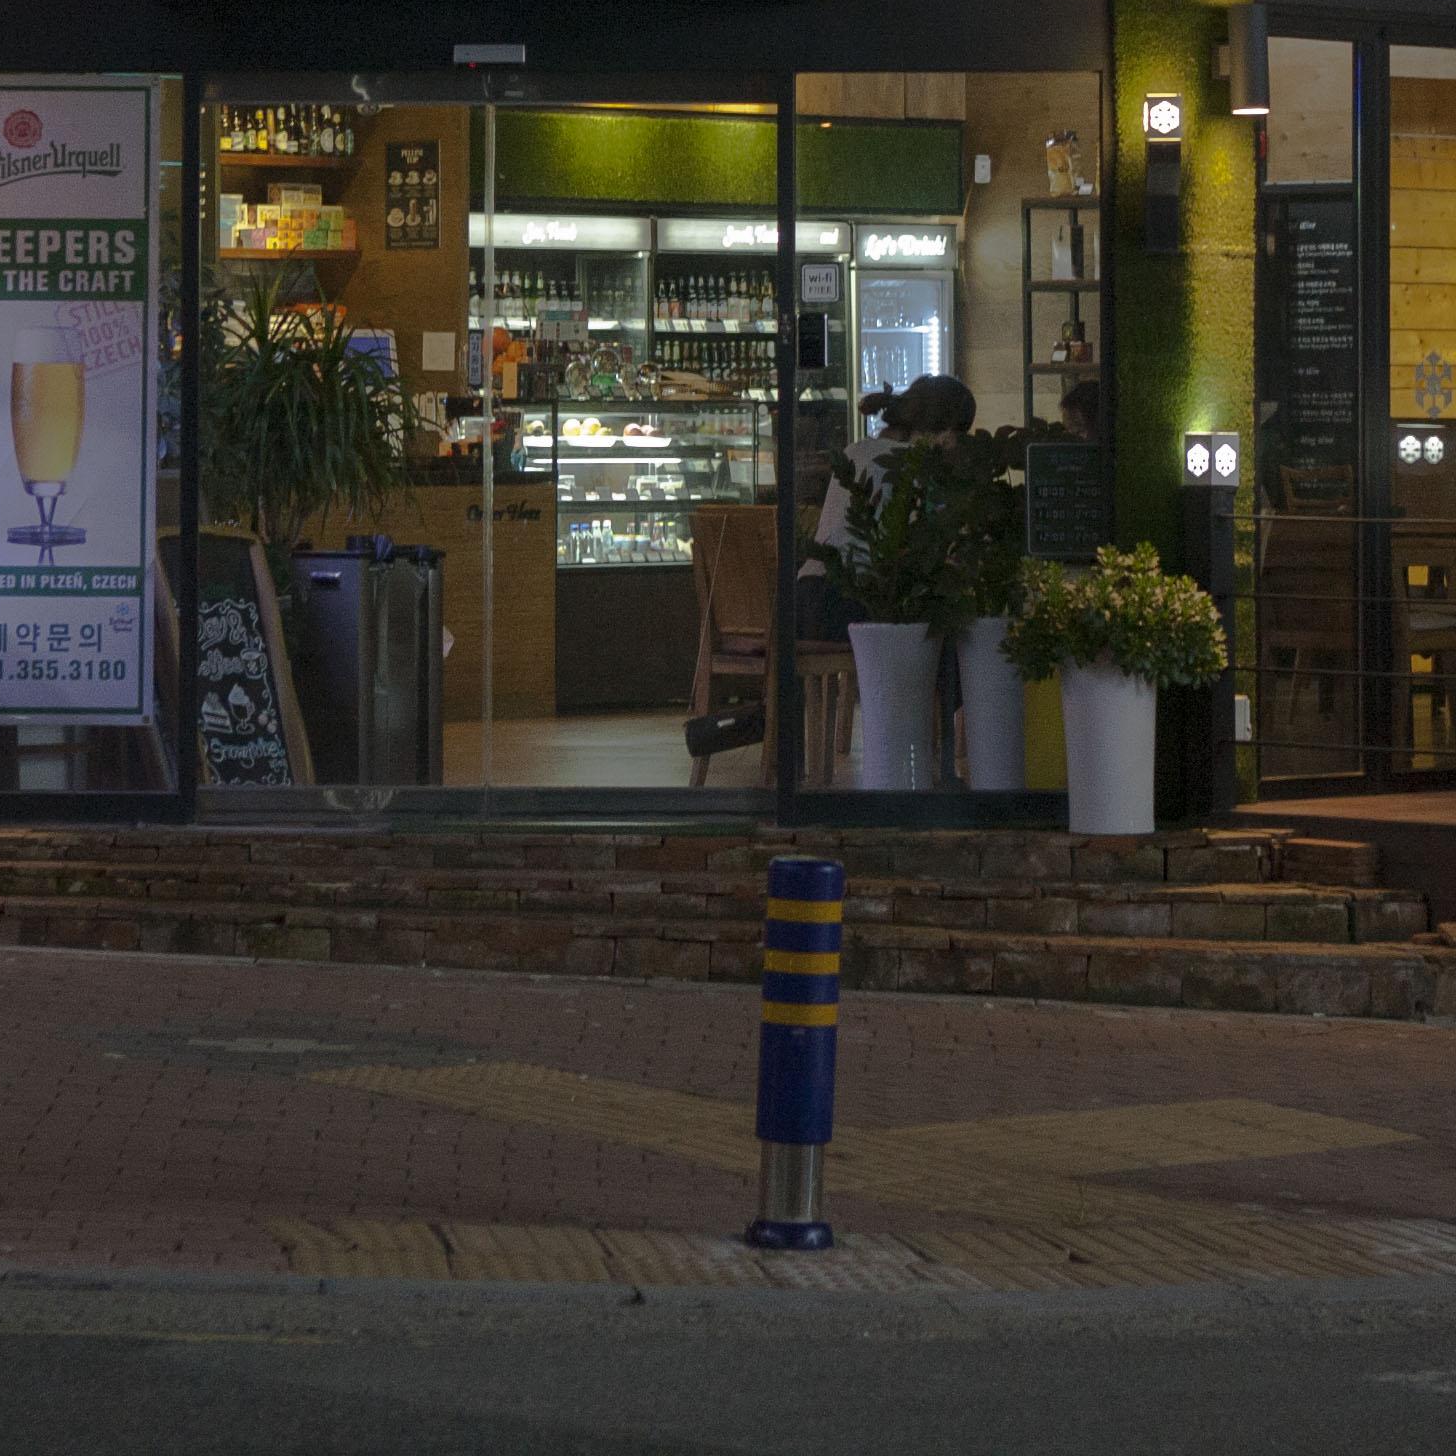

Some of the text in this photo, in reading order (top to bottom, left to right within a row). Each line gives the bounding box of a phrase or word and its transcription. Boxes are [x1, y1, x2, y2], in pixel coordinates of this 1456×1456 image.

[49, 141, 121, 177] Urquell
[4, 270, 49, 292] THE
[58, 270, 135, 292] CRAFT
[21, 575, 36, 589] IN
[92, 574, 136, 590] CZECH
